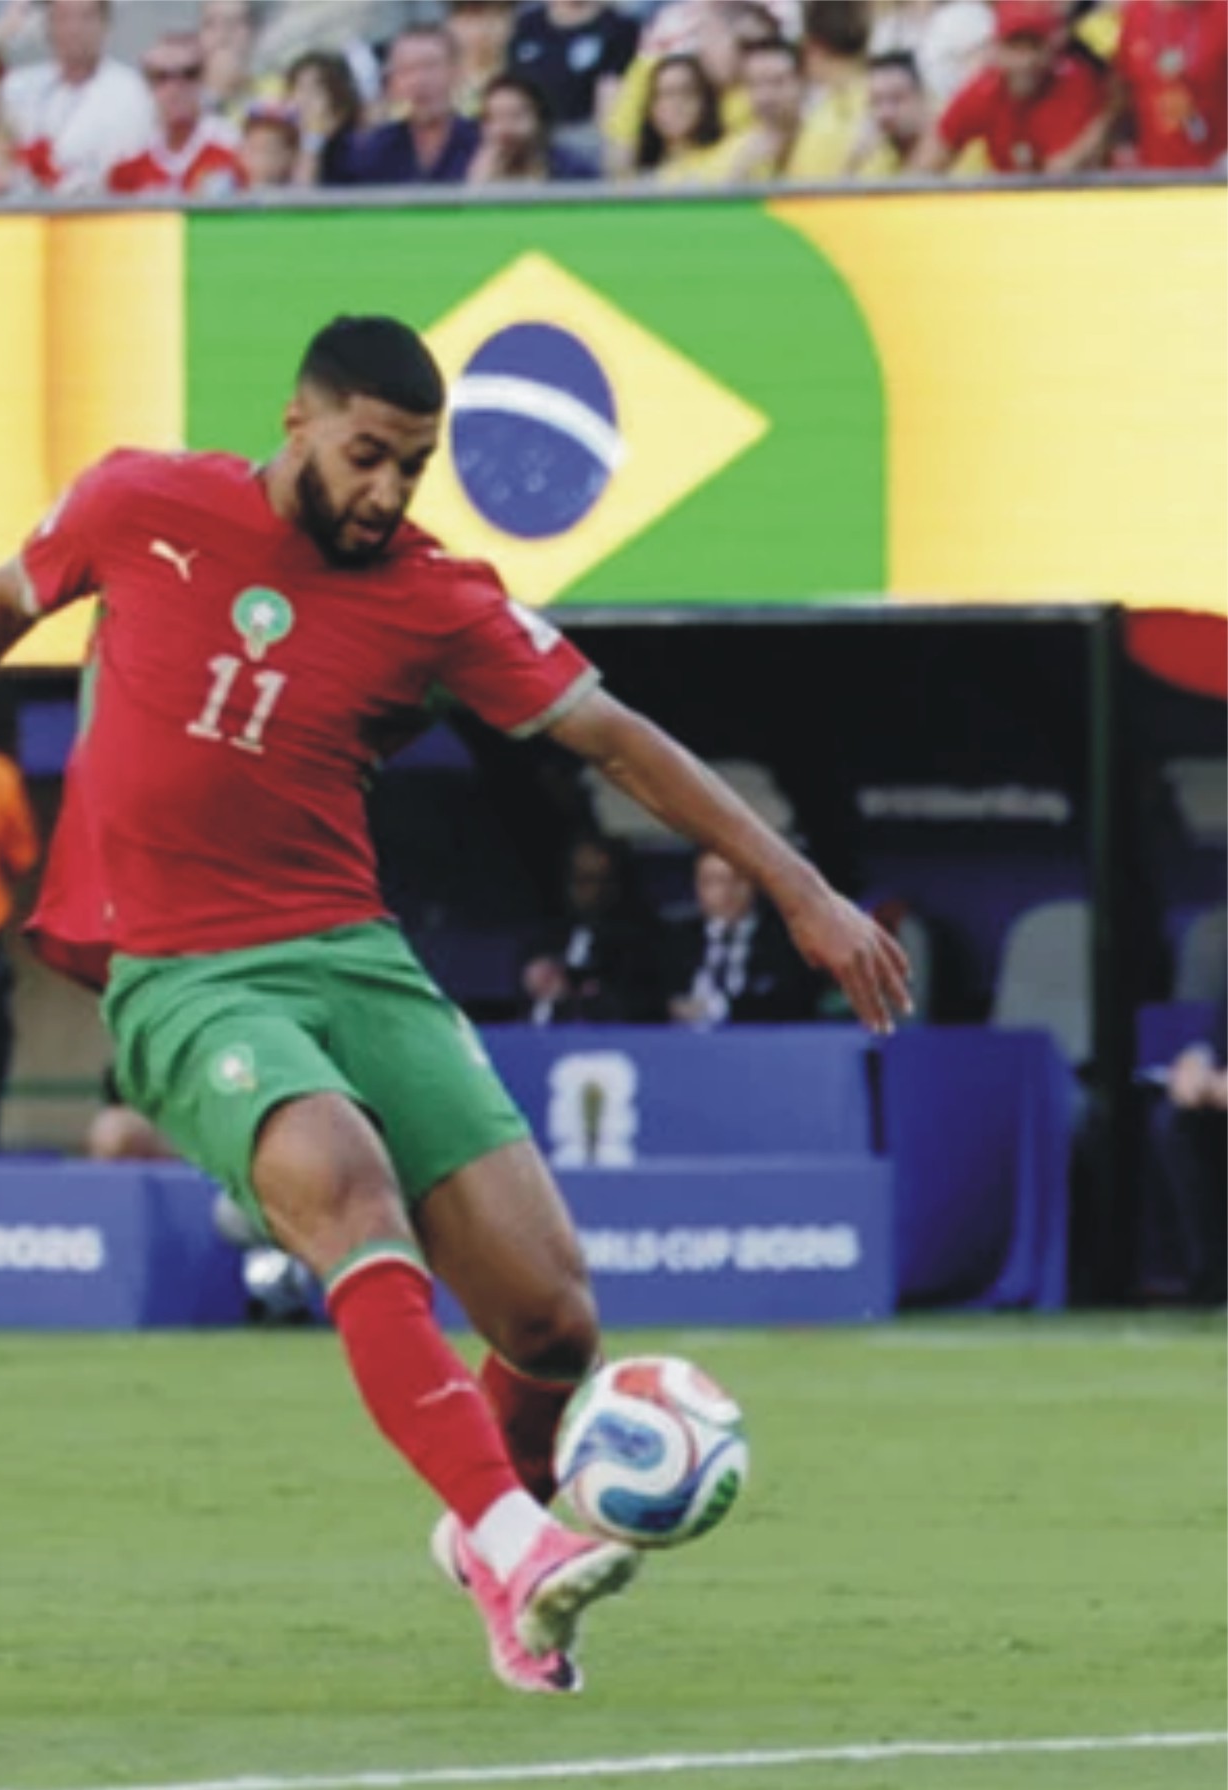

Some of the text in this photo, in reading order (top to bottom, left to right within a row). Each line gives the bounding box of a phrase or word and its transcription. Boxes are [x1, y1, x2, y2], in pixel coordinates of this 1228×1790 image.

[186, 653, 287, 755] 11
[578, 1228, 660, 1271] RLD
[663, 1227, 730, 1271] CUP
